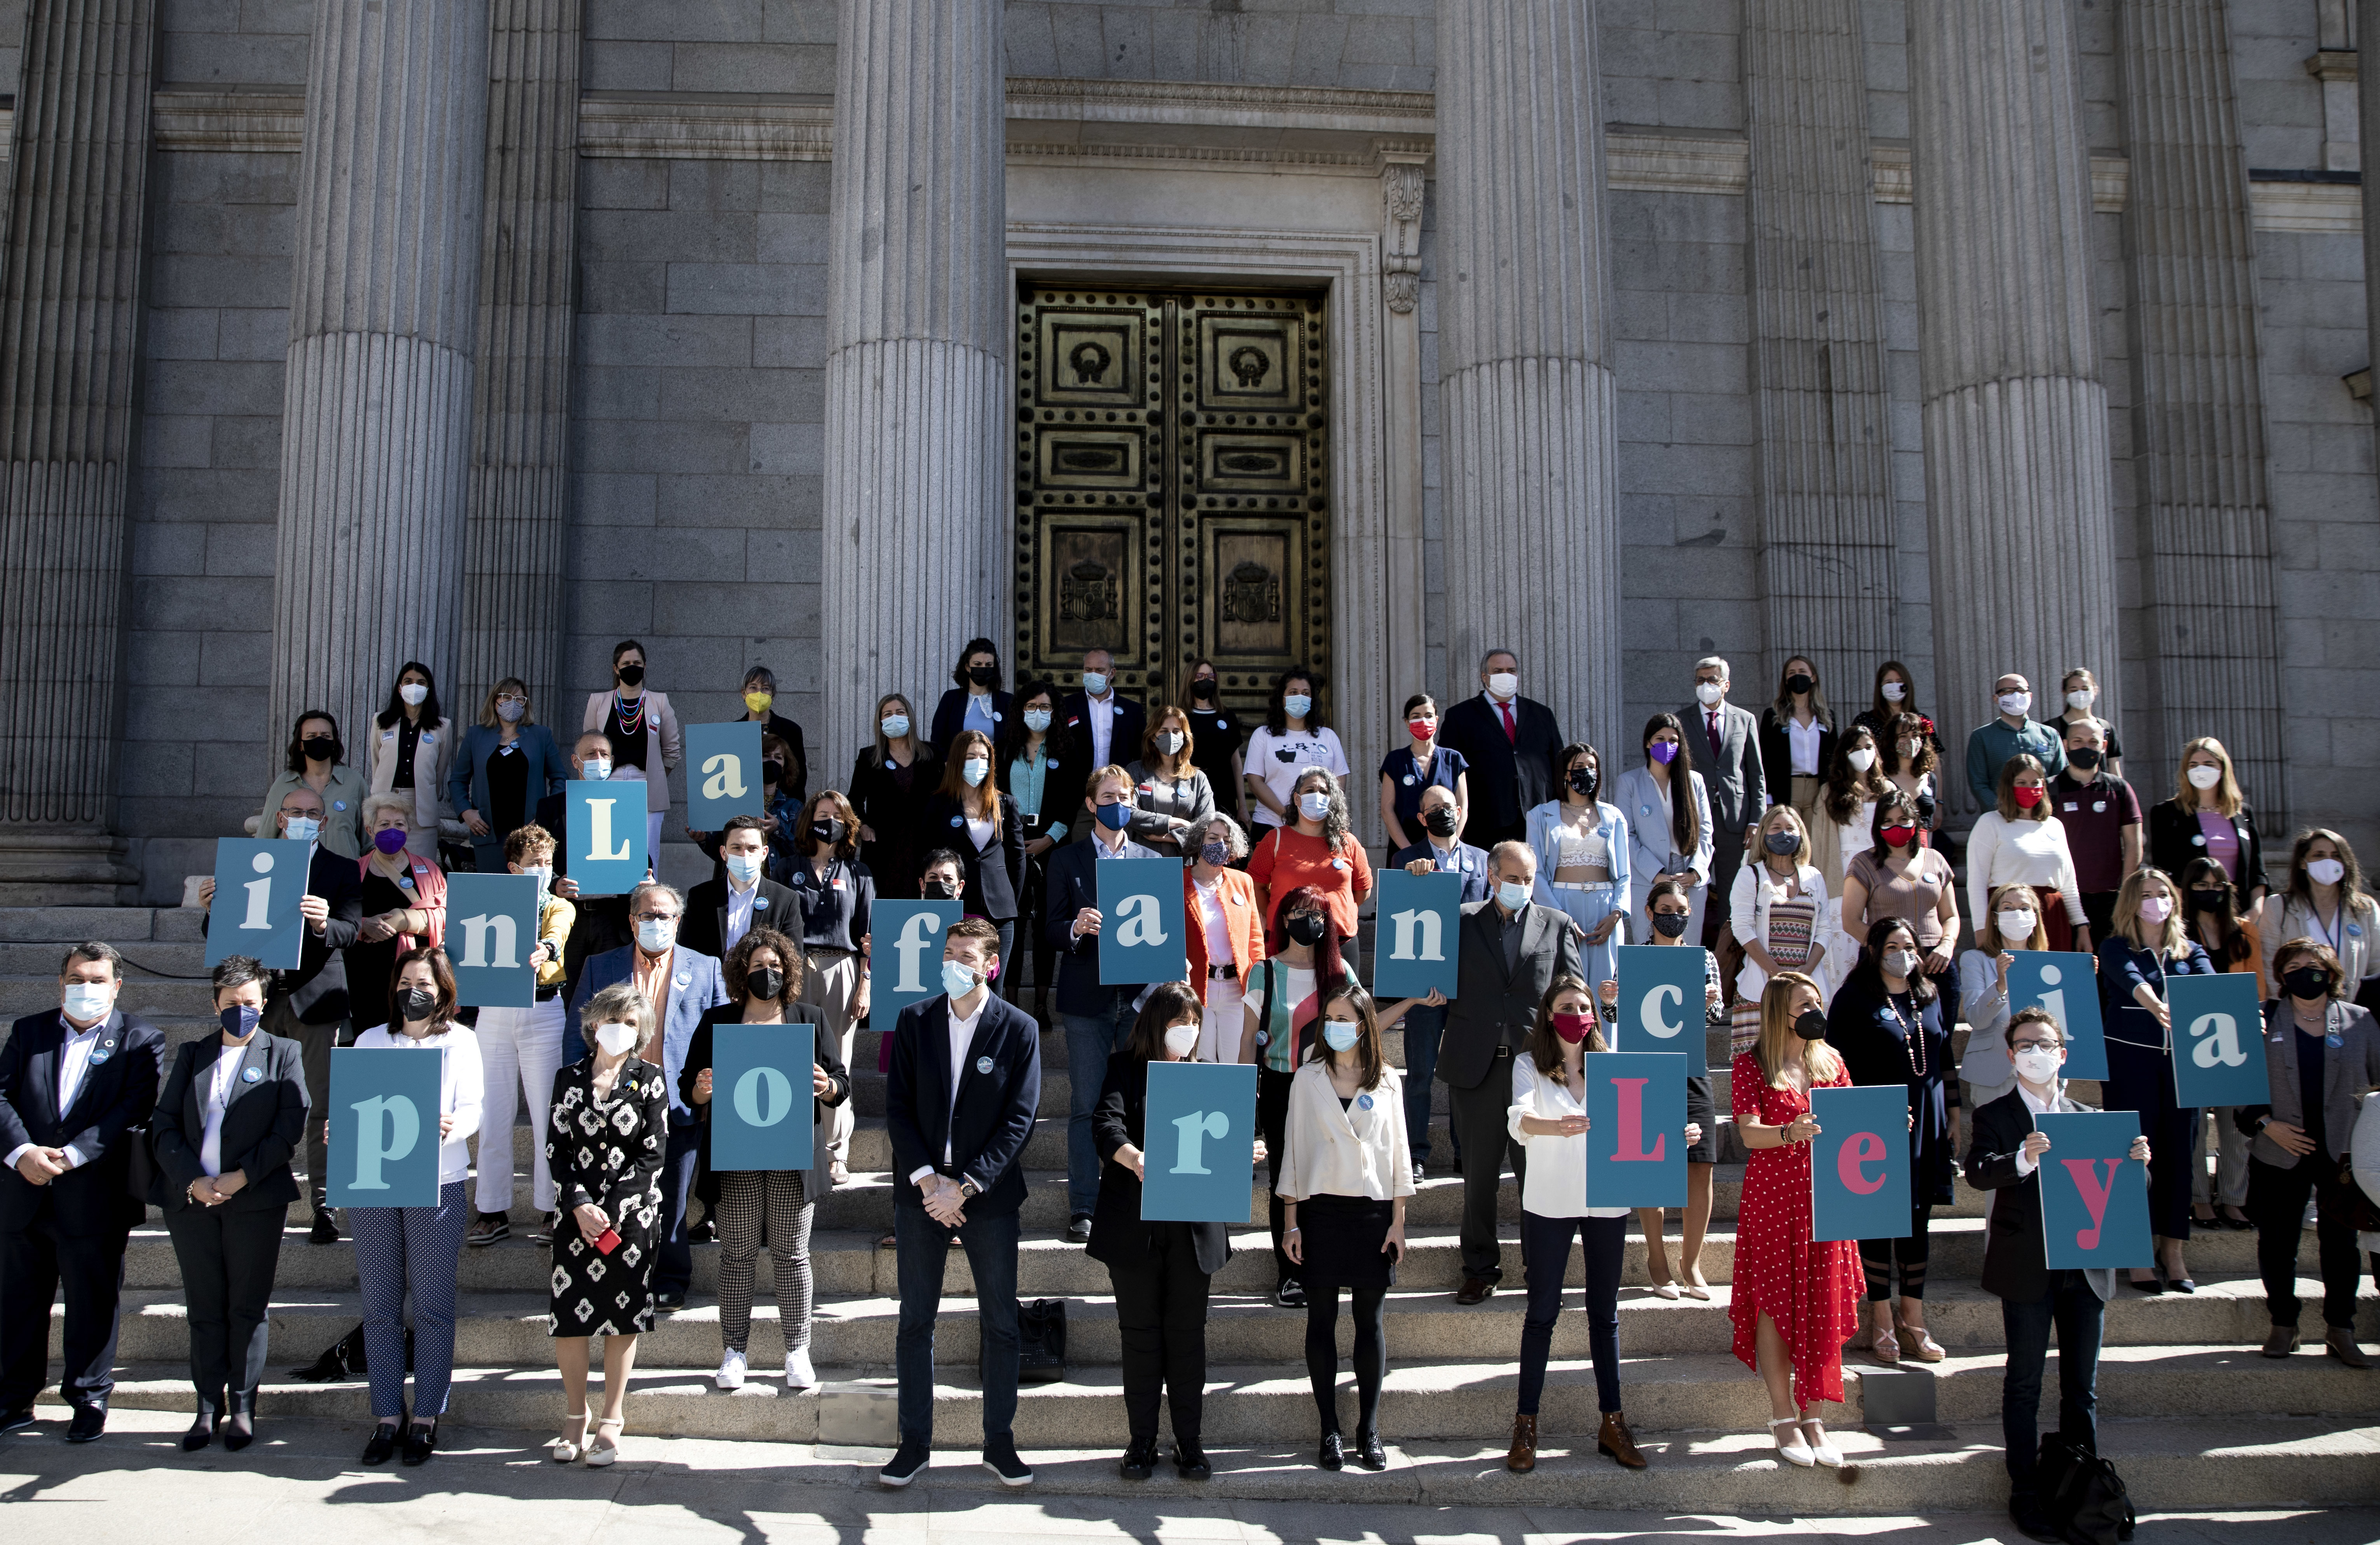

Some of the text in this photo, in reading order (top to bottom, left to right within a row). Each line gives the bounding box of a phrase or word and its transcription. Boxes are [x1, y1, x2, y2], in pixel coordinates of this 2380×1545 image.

[702, 754, 747, 799] a
[585, 799, 630, 860] L
[239, 853, 274, 929] i
[1116, 895, 1167, 947] a
[459, 914, 520, 968] n
[893, 913, 940, 992] f
[1390, 909, 1445, 961] n
[1641, 985, 1683, 1038] c
[2037, 964, 2074, 1040] i
[2189, 1013, 2246, 1067] a
[734, 1067, 792, 1126] o
[1610, 1078, 1664, 1161] L
[348, 1095, 419, 1189] p
[1169, 1111, 1229, 1174] r
[1838, 1132, 1886, 1194] e
[2061, 1159, 2122, 1249] y
